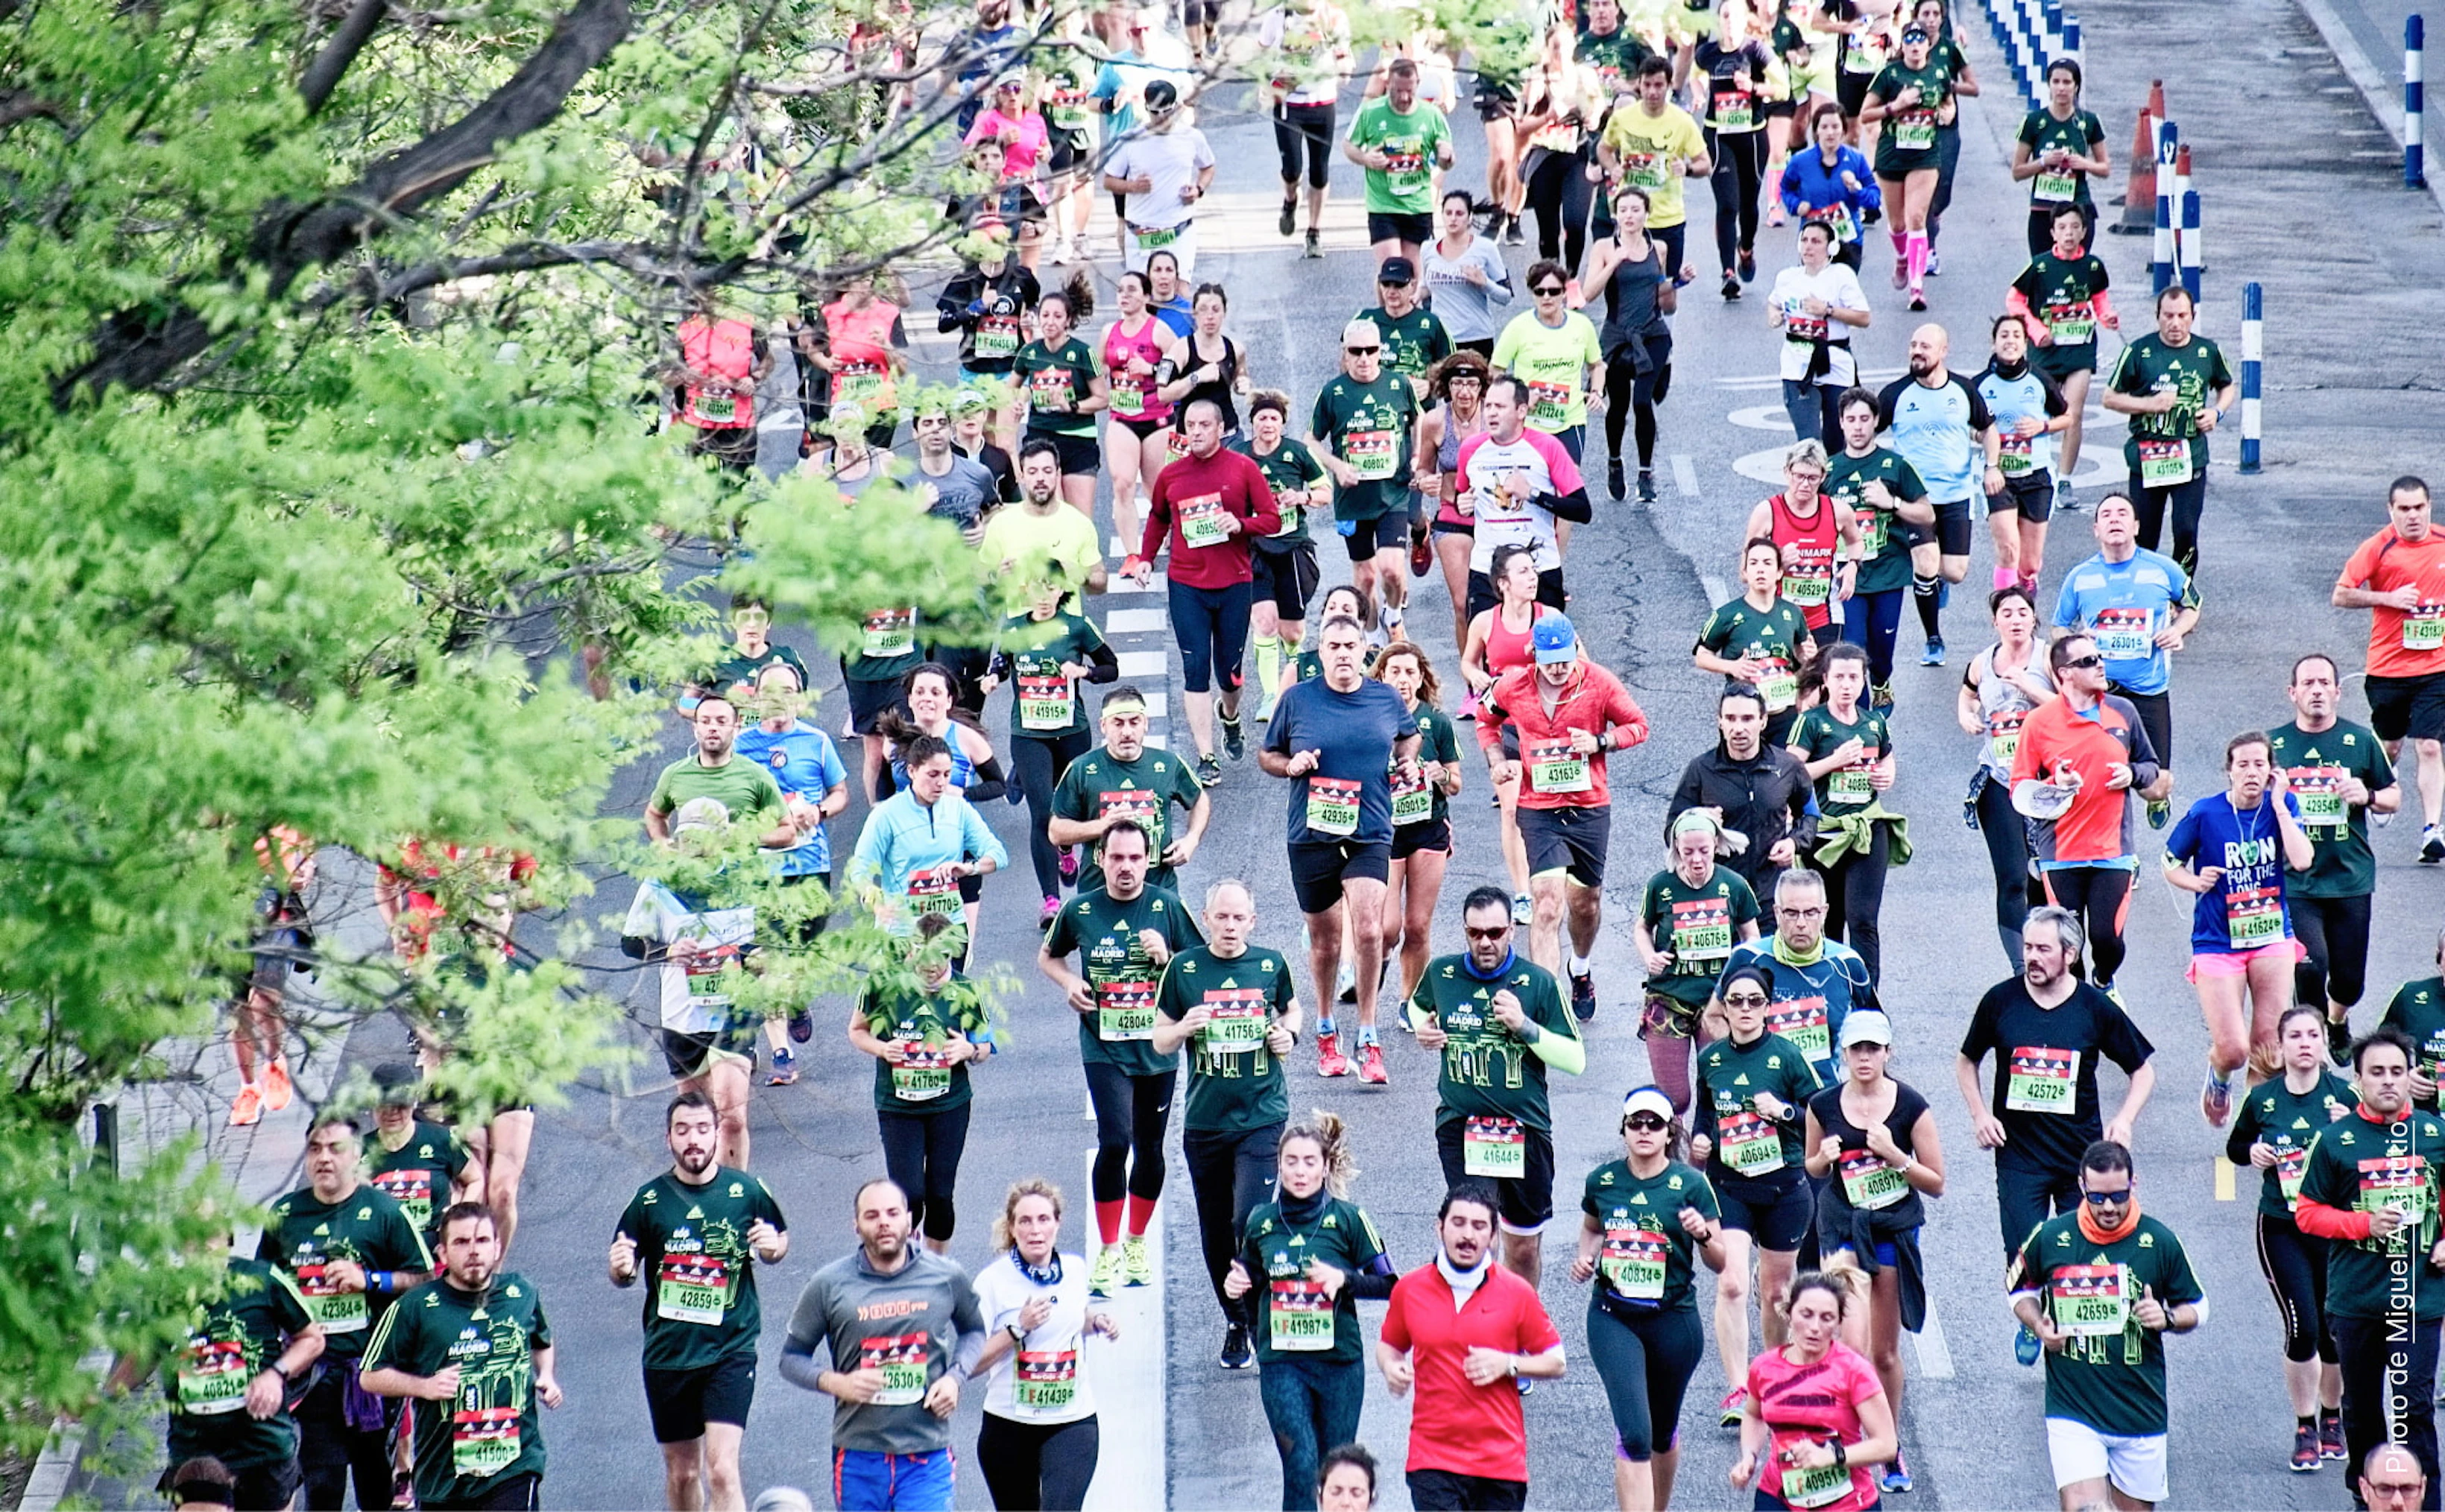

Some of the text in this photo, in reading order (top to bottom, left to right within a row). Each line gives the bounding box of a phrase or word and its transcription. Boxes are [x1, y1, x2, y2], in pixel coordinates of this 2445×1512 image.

[1537, 403, 1560, 417] 41224
[1362, 458, 1384, 470] 40802
[1796, 584, 1820, 596] 40529
[2110, 636, 2136, 648] 26301
[1035, 704, 1059, 718] 41915
[1548, 768, 1574, 781] 43163
[1395, 797, 1421, 814] 40901
[2305, 800, 2334, 813] 42954
[1321, 809, 1348, 823] 42936
[2227, 864, 2276, 885] FOR THE
[926, 897, 952, 911] 41770
[2247, 918, 2274, 936] 41624
[1694, 931, 1721, 948] 40676
[1091, 949, 1125, 958] MADRID
[1117, 1015, 1146, 1029] 42804
[1447, 1016, 1482, 1027] MADRID
[892, 1031, 924, 1040] MADRID
[1224, 1025, 1254, 1040] 41756
[2425, 1043, 2445, 1052] MAD
[2028, 1083, 2058, 1100] 42572
[1715, 1103, 1742, 1112] MADRID
[1483, 1149, 1513, 1163] 41644
[1740, 1148, 1770, 1165] 40694
[1867, 1177, 1897, 1196] 40897
[1604, 1222, 1638, 1231] MADRID
[664, 1241, 702, 1253] MADRID
[1268, 1265, 1299, 1277] MADRID
[1621, 1266, 1653, 1283] 40834
[679, 1291, 712, 1310] 42859
[321, 1303, 354, 1318] 42384
[2075, 1304, 2110, 1321] 42659
[1281, 1319, 1322, 1335] F 41987
[448, 1341, 491, 1356] MADRID
[203, 1382, 236, 1399] 40821
[1028, 1388, 1067, 1405] F 41439
[475, 1446, 508, 1462] 41500
[1804, 1468, 1839, 1491] 40951
